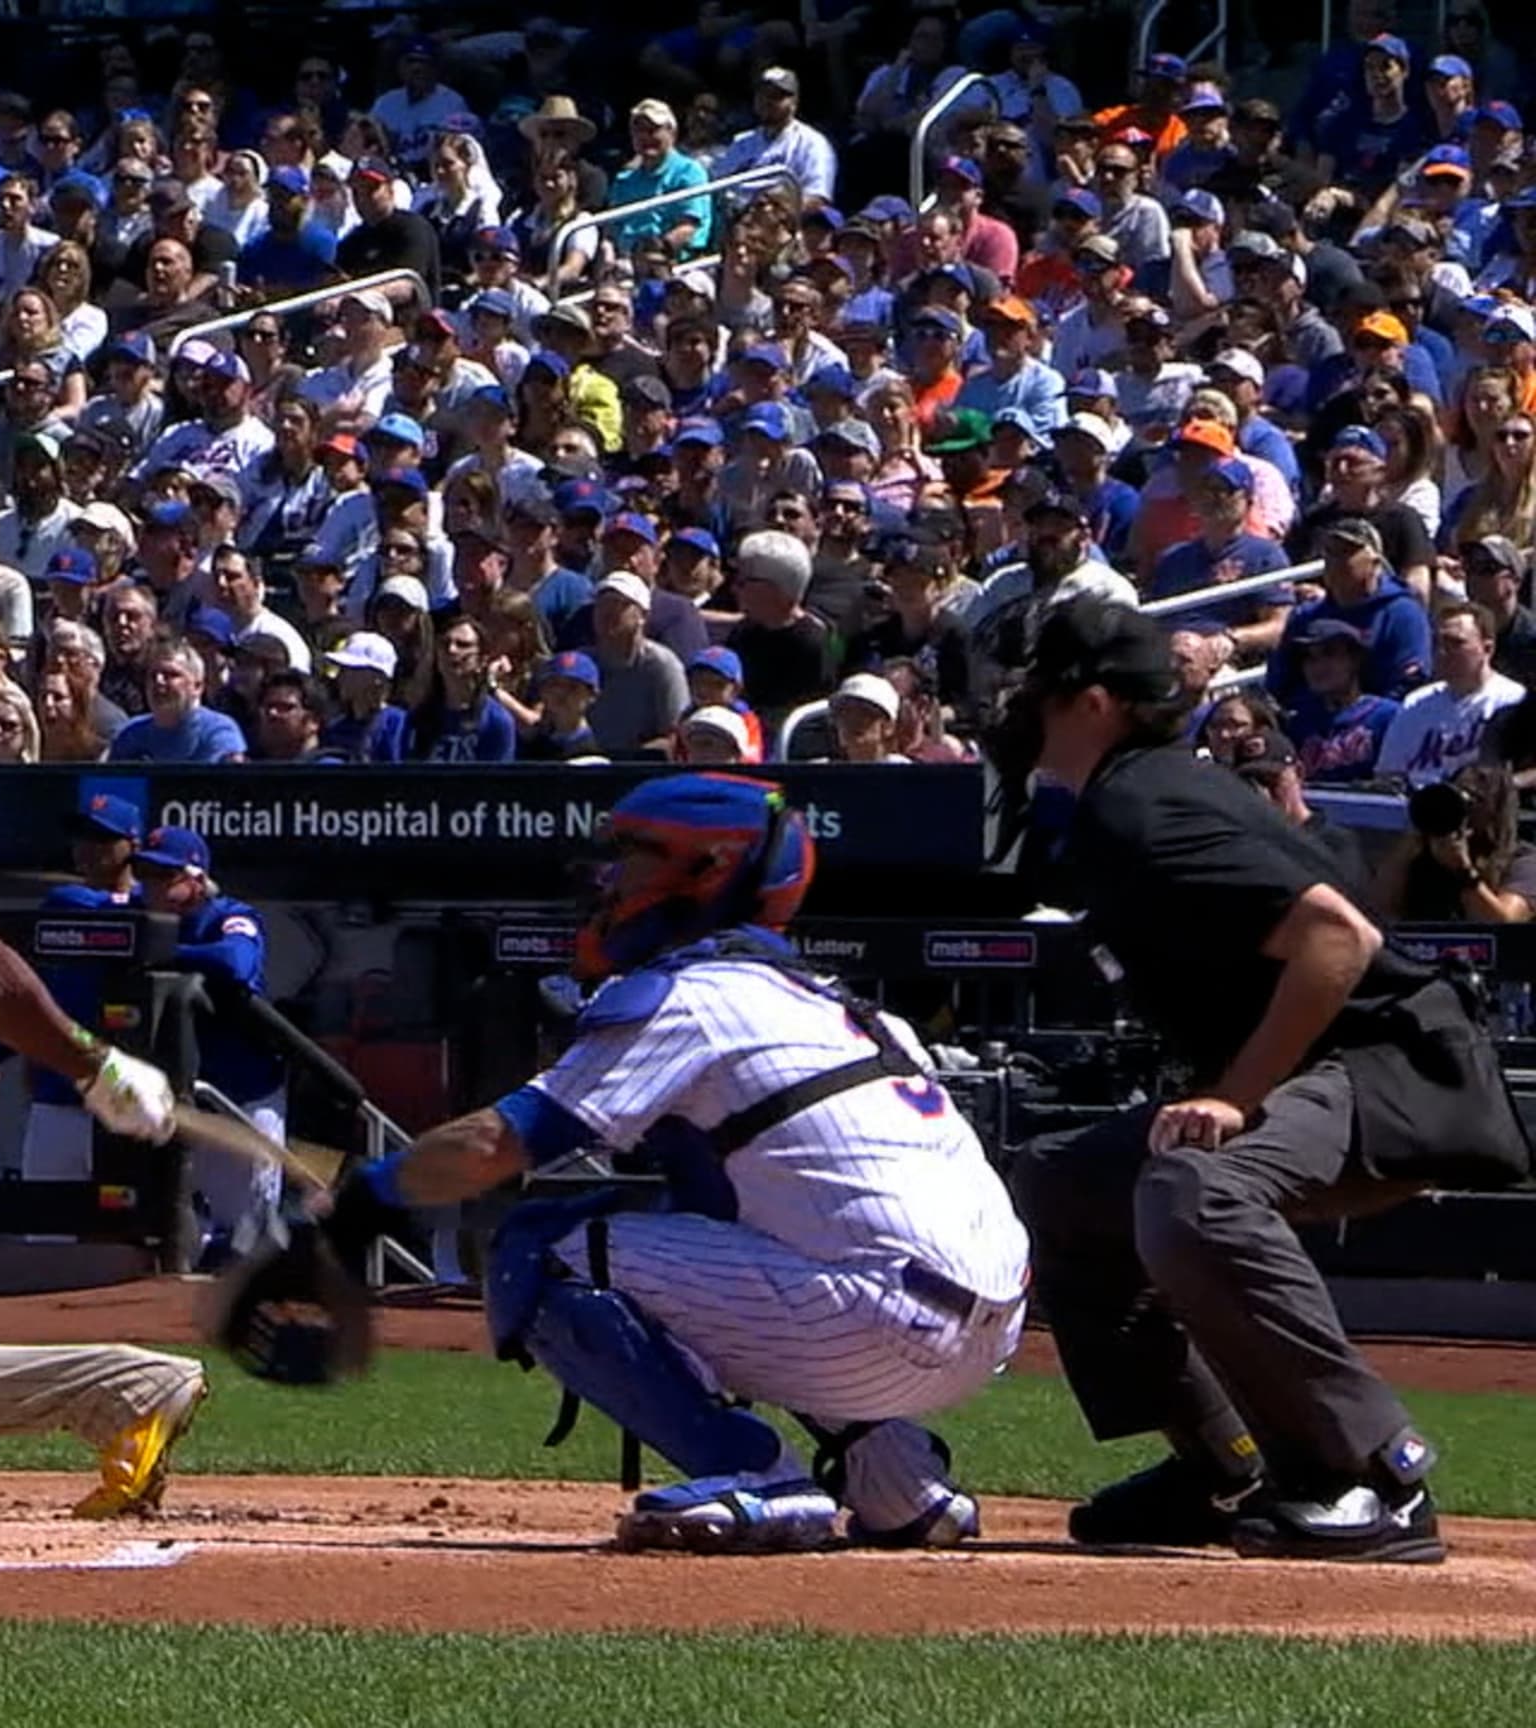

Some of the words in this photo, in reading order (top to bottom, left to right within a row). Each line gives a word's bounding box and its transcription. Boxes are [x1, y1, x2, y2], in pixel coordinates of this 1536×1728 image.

[161, 801, 282, 837] Official
[293, 801, 440, 846] Hospital
[450, 801, 491, 838] of
[496, 801, 556, 838] the
[805, 938, 866, 959] Lottery
